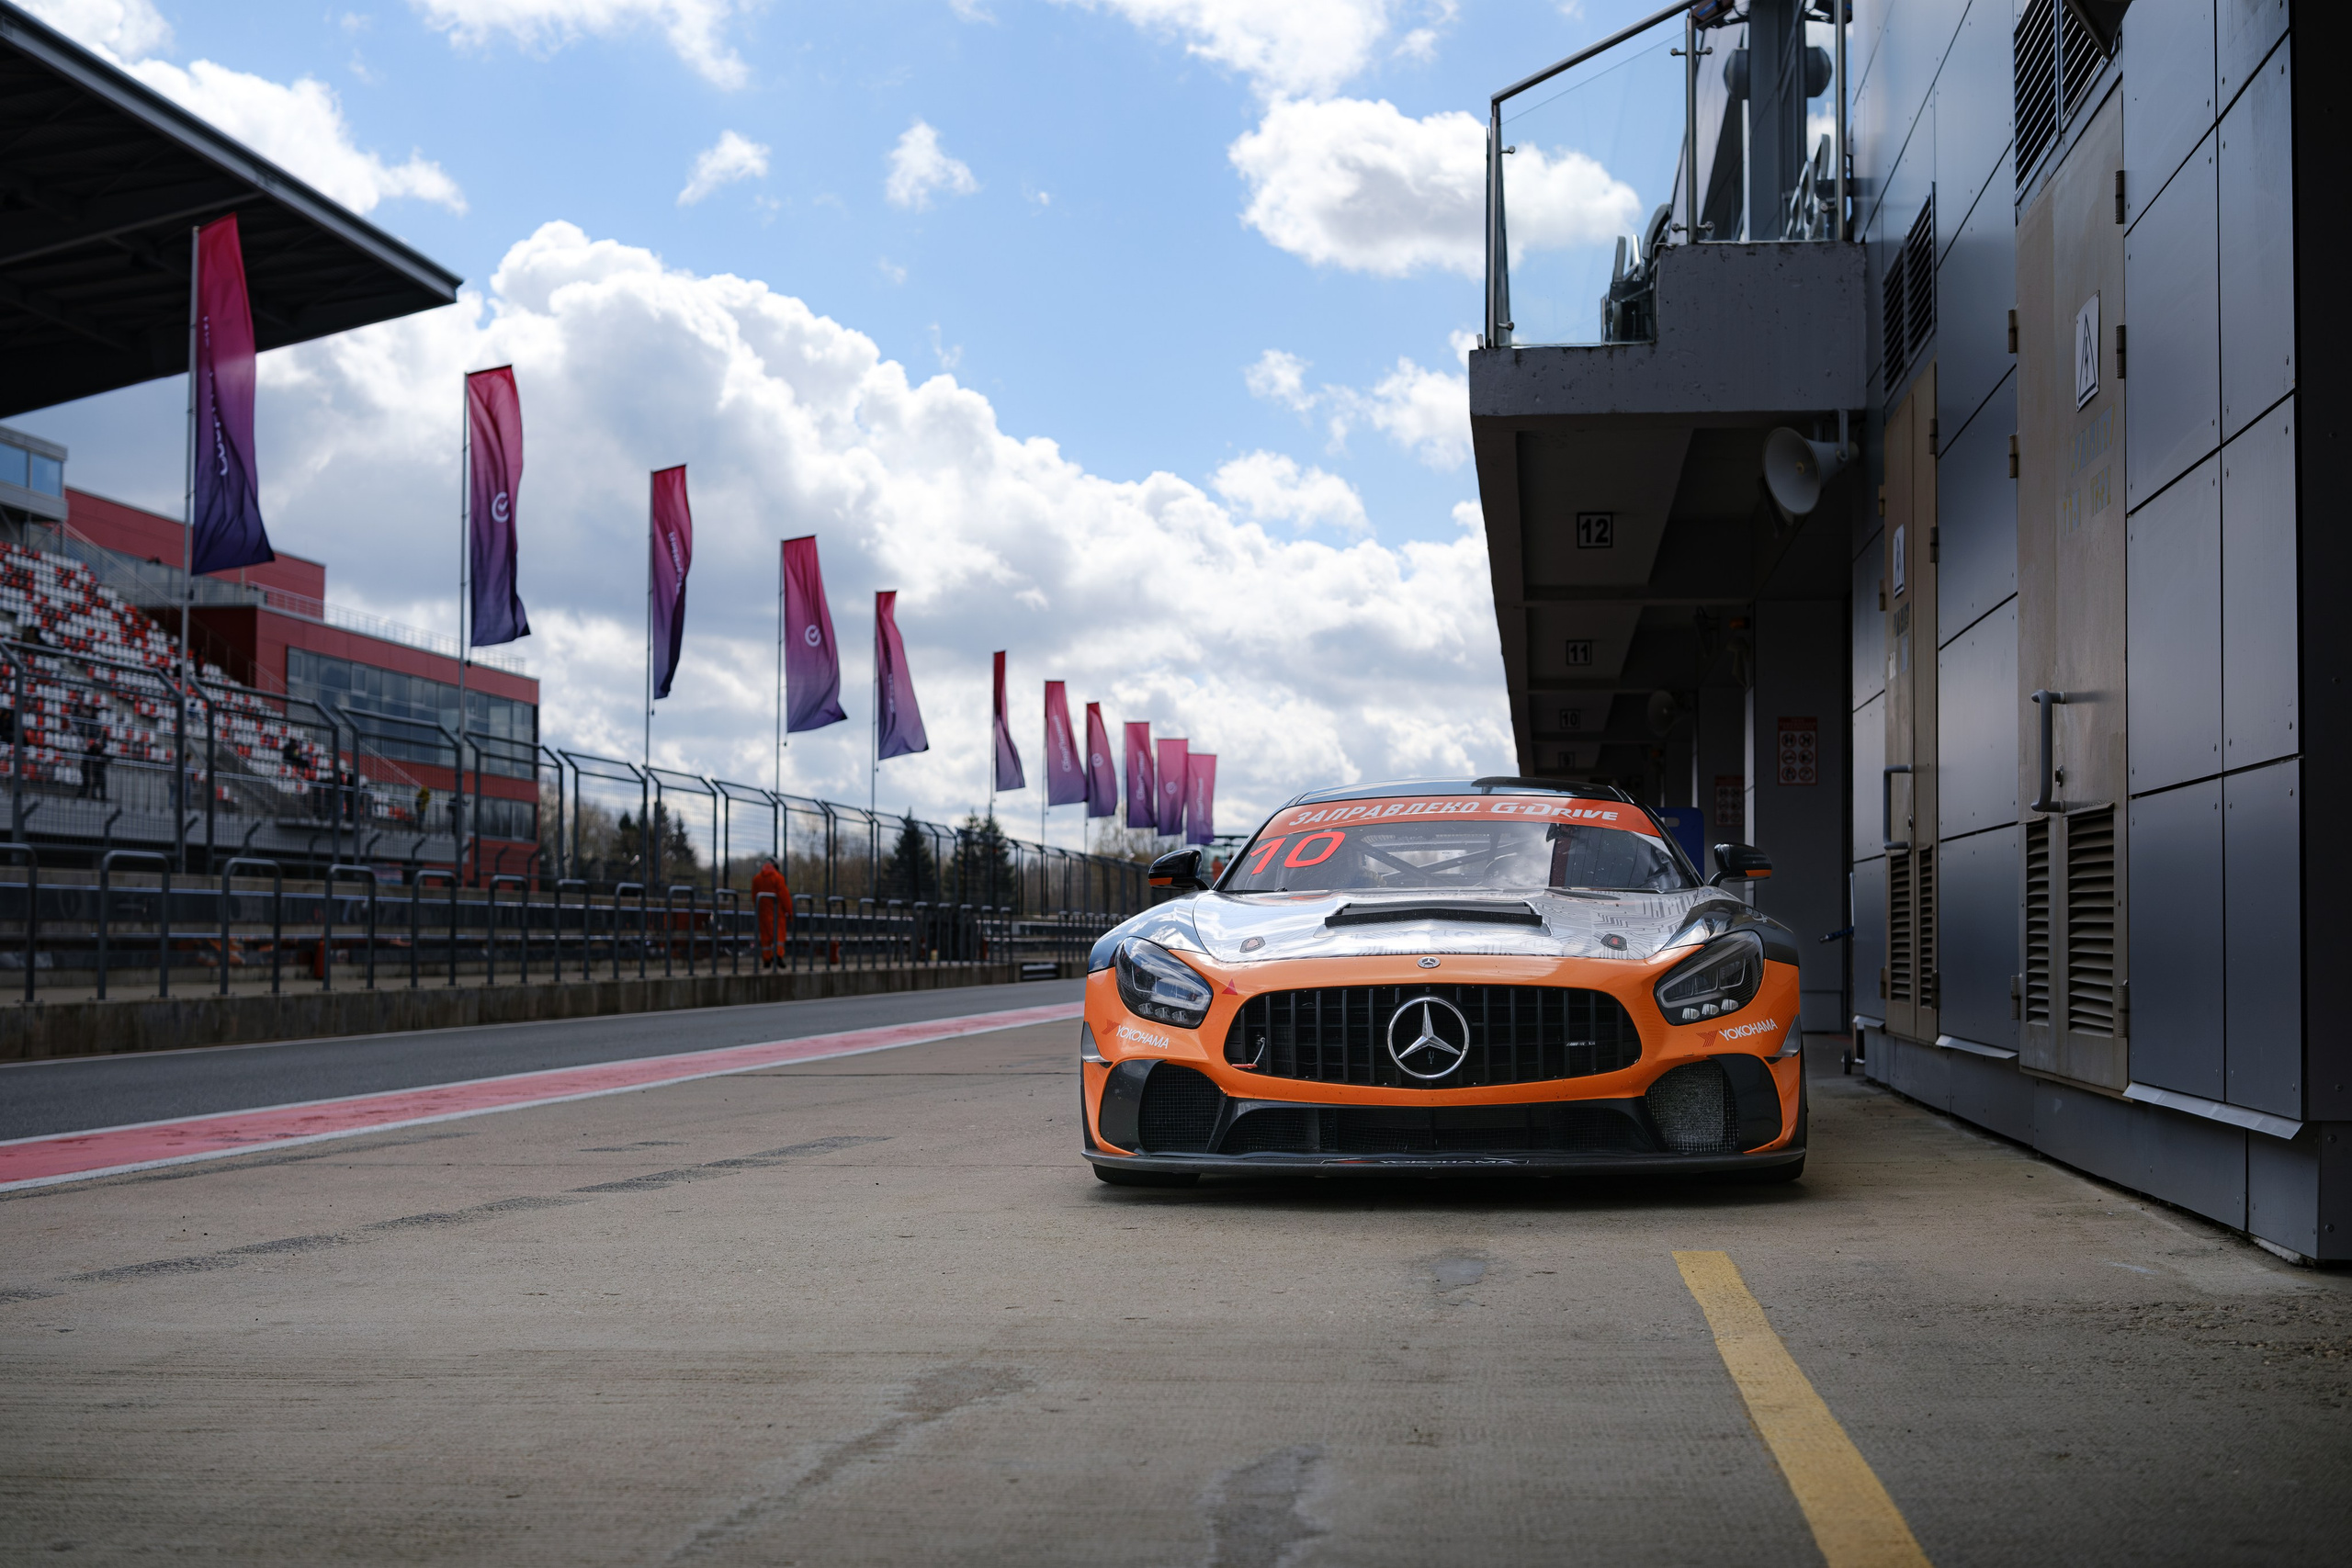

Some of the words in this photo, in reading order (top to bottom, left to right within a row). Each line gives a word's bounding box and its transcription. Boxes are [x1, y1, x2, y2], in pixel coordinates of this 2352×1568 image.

[1581, 518, 1609, 544] 12
[1570, 644, 1589, 661] 11
[1563, 712, 1577, 726] 10
[1289, 801, 1480, 826] ЗАПРАВЛЕНО
[1250, 831, 1346, 875] 10
[1115, 1024, 1170, 1050] YOKOHAMA
[1719, 1018, 1779, 1042] YOKOHAMA
